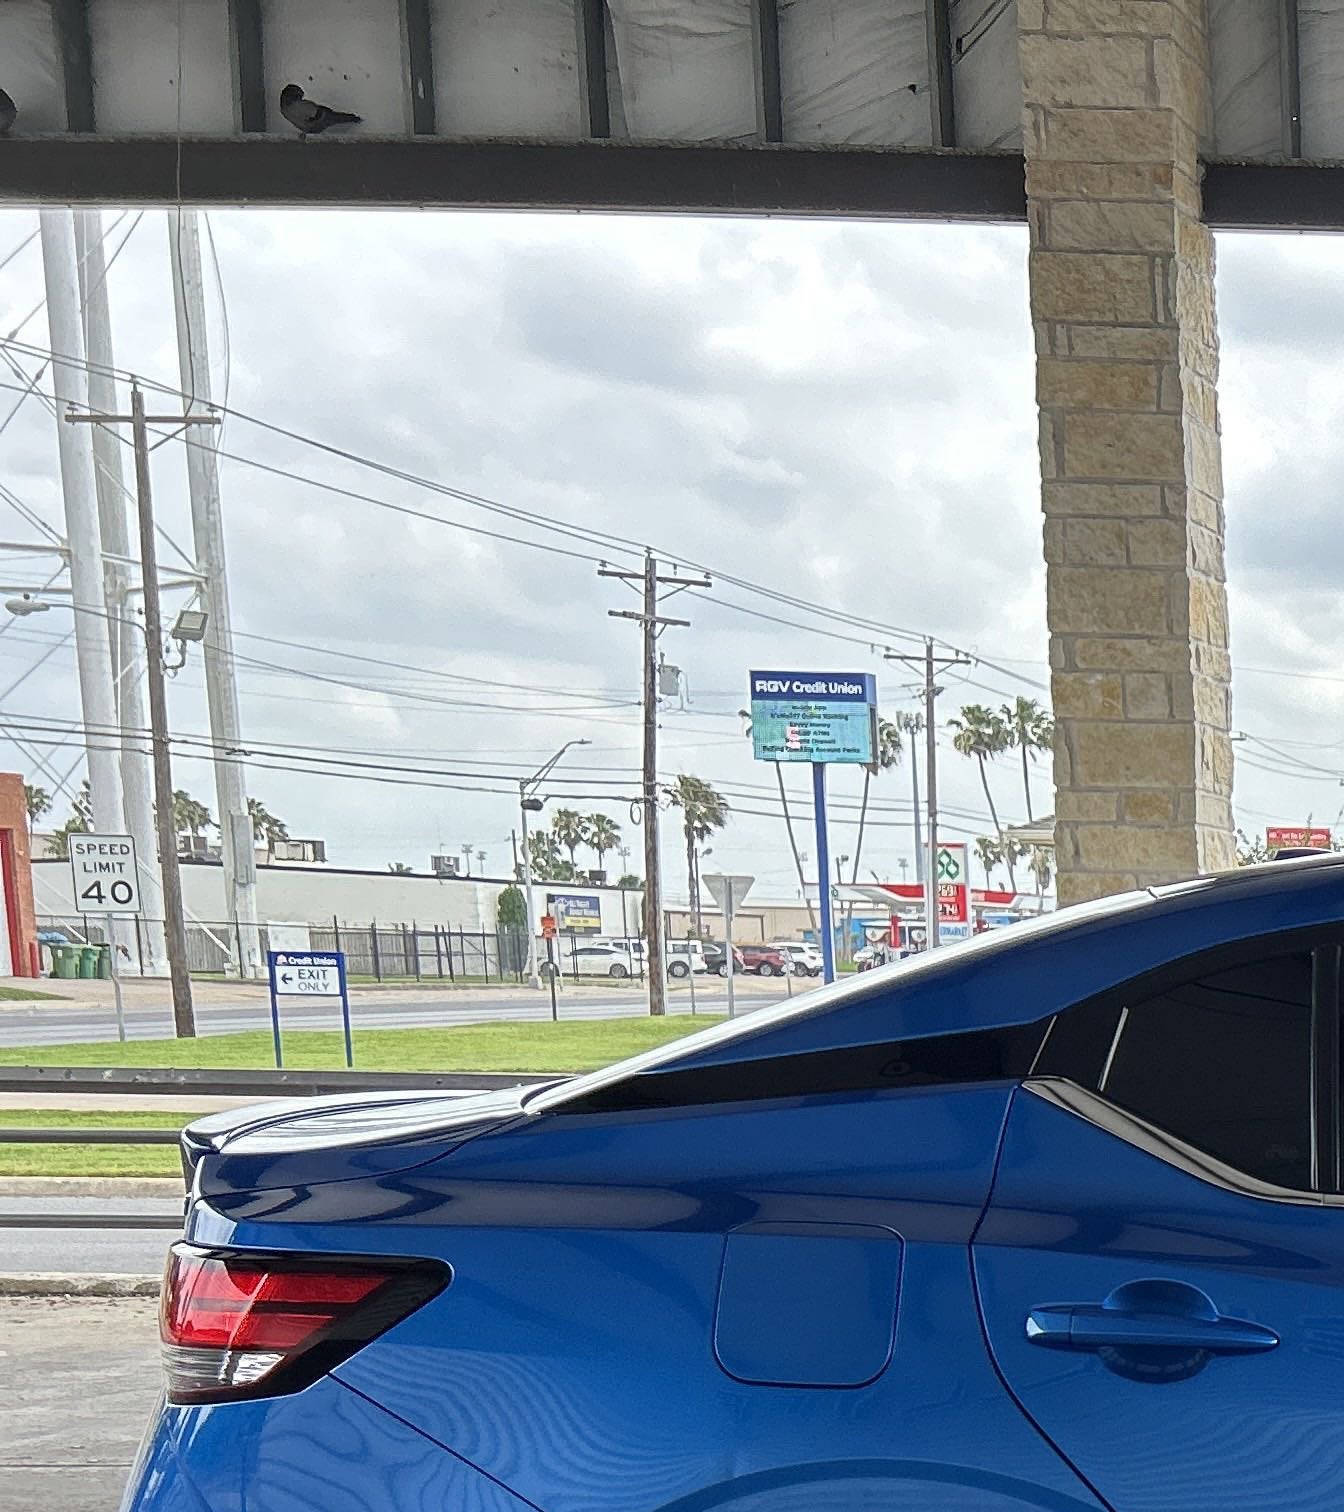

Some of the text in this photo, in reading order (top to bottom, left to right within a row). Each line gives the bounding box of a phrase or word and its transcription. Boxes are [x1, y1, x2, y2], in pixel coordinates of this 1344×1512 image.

[755, 680, 863, 695] RGV Credit Union
[75, 843, 130, 855] SPEED
[82, 861, 125, 873] LIMIT
[81, 880, 133, 905] 40
[288, 956, 313, 965] Credit
[297, 968, 328, 980] EXIT
[297, 981, 330, 992] ONLY
